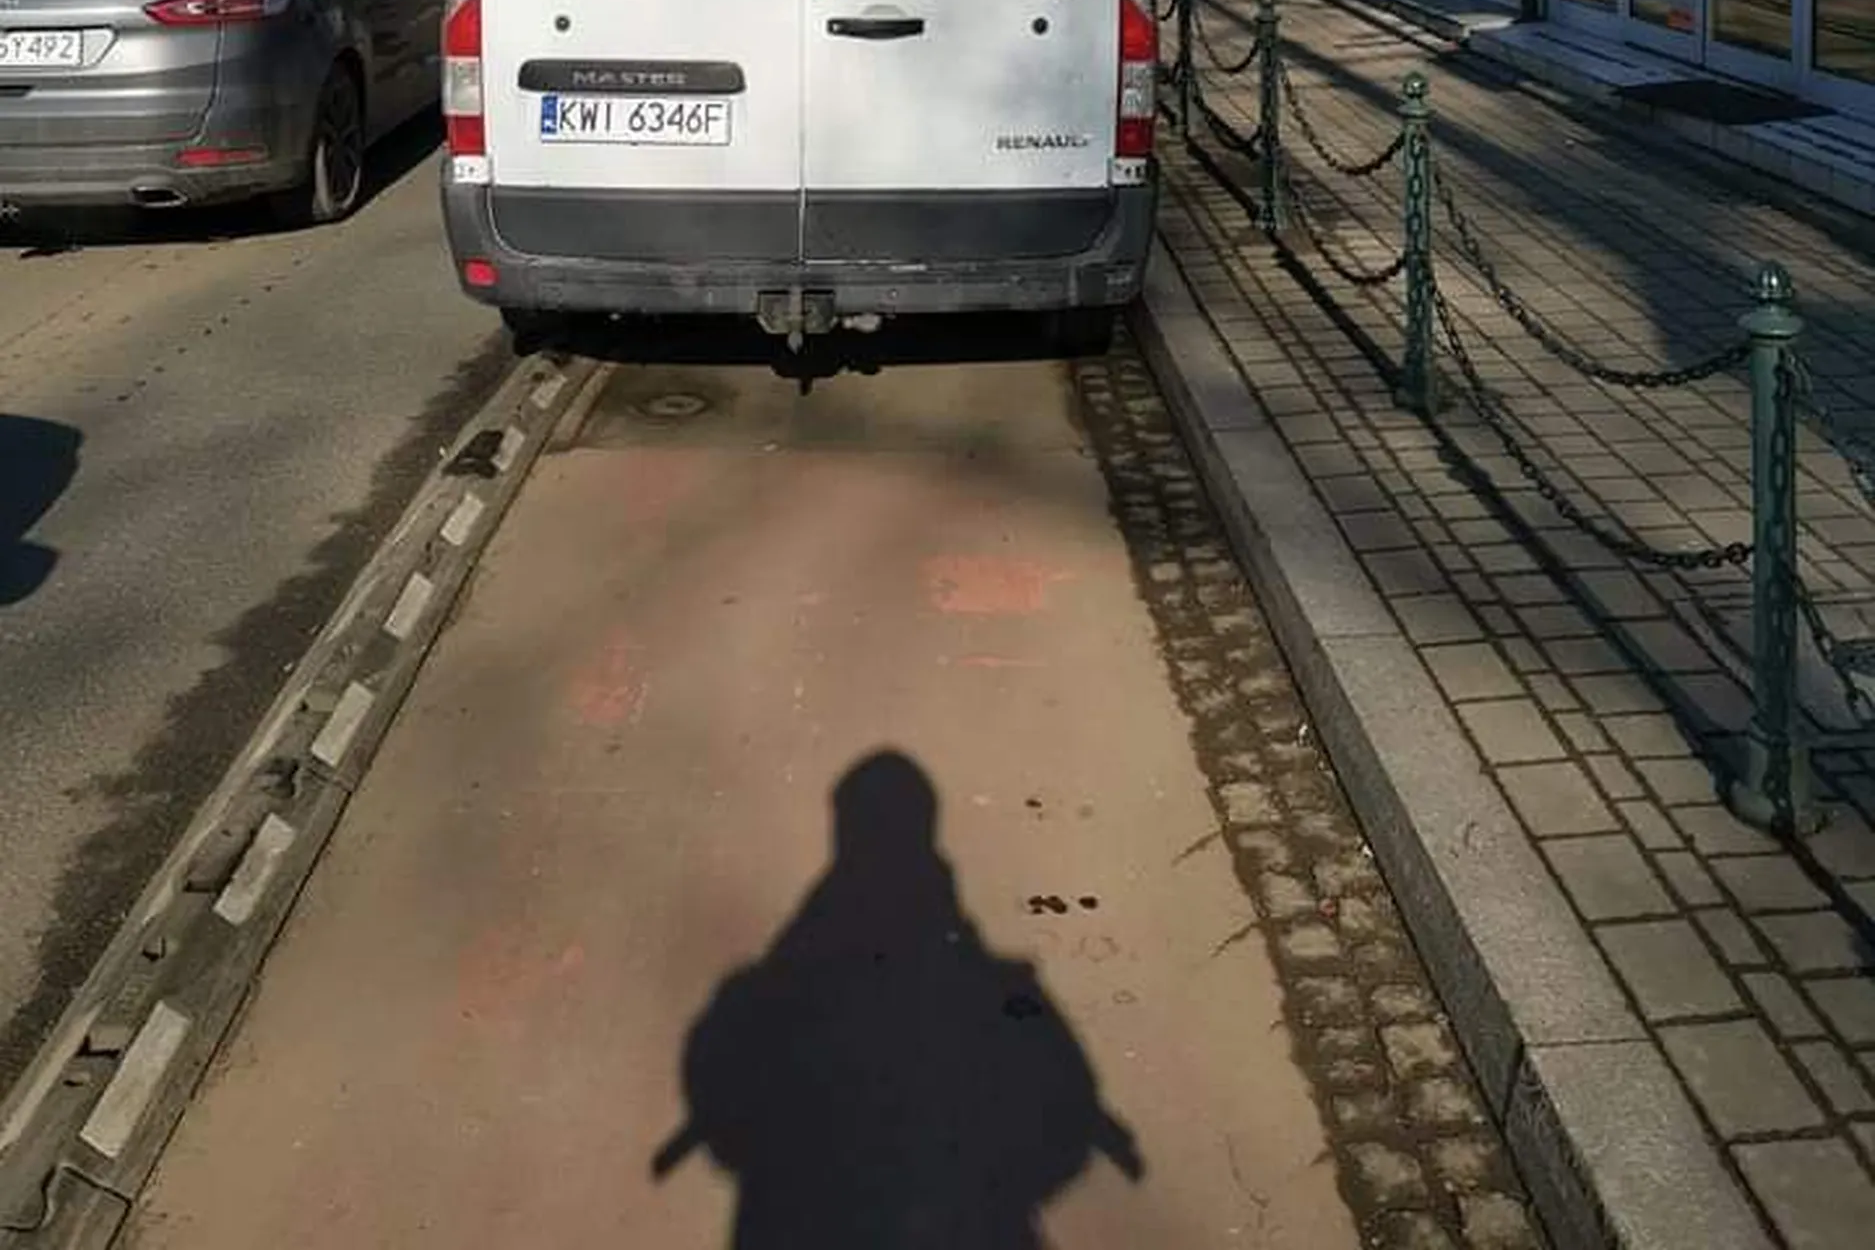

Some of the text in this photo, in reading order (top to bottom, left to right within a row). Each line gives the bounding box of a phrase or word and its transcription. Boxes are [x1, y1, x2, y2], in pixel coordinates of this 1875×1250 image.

[571, 70, 688, 87] MASTER
[559, 101, 612, 132] KWI
[627, 101, 723, 134] 6346F
